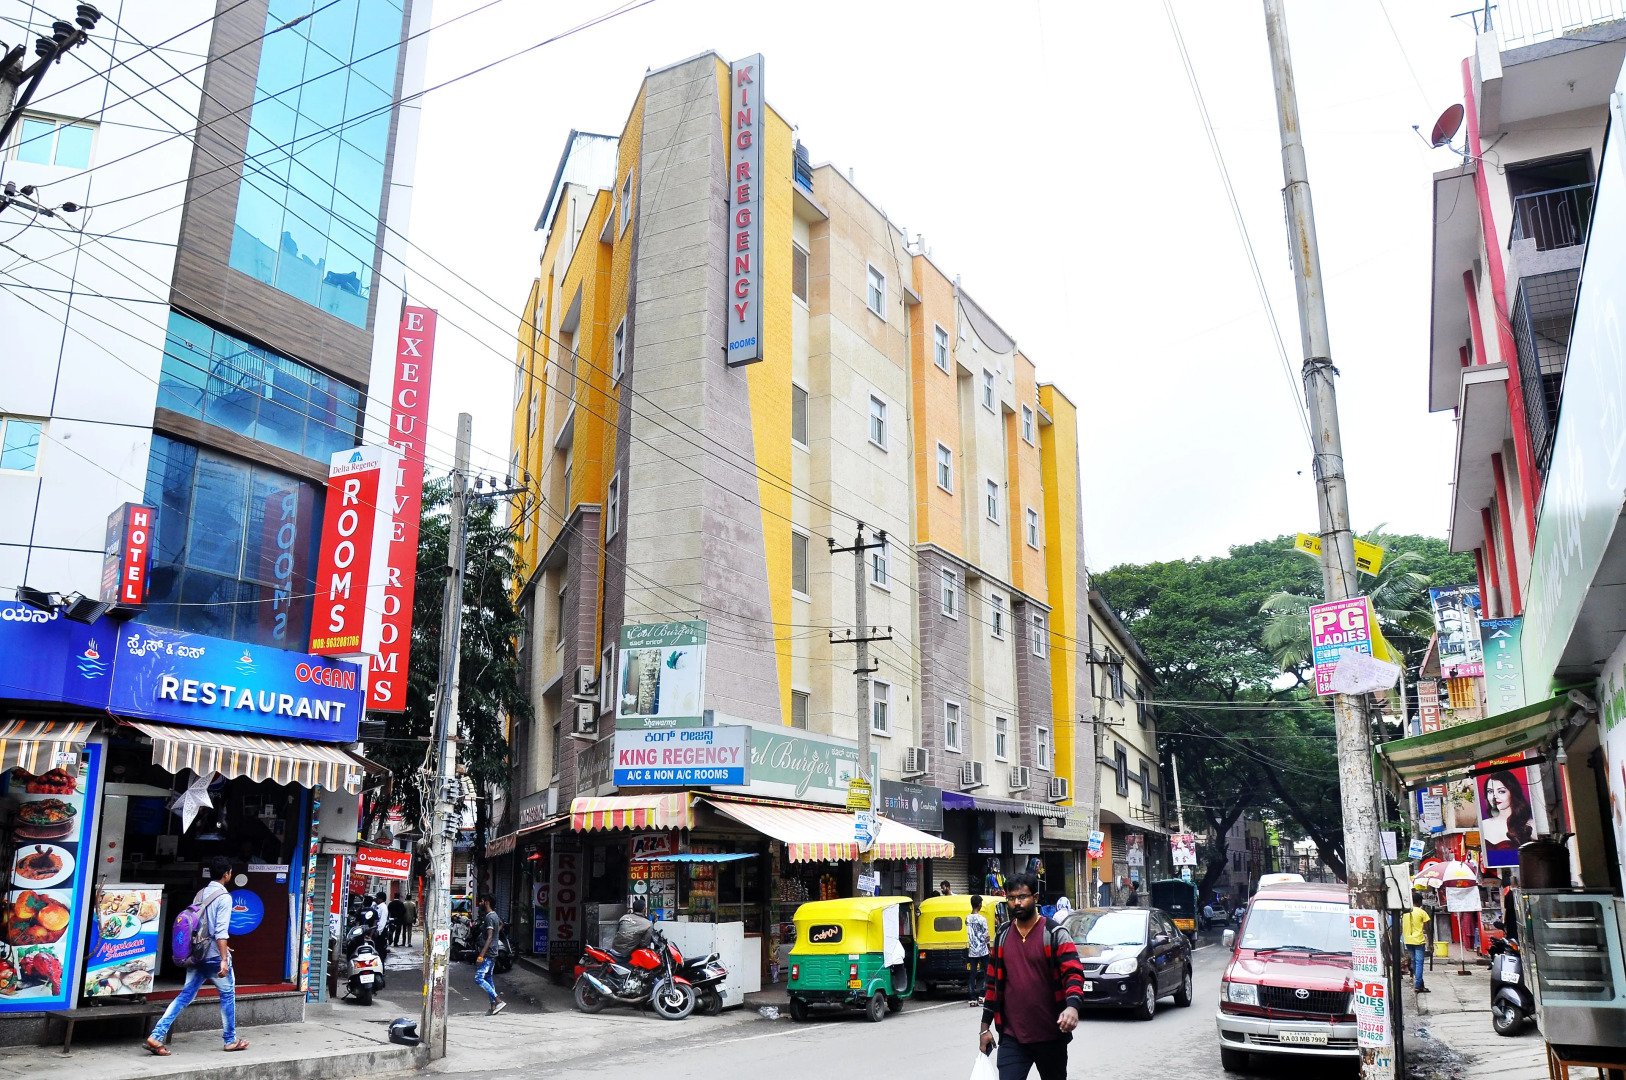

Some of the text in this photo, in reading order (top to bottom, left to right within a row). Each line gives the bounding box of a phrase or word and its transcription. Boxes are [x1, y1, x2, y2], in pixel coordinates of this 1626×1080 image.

[734, 65, 753, 323] KING REGENCY
[729, 337, 756, 351] ROOMS
[333, 460, 379, 474] Delta Regency
[370, 311, 424, 702] EXECUTIVE ROOMS
[126, 512, 148, 599] HOTEL
[328, 478, 361, 634] ROOMS
[654, 623, 695, 646] Burger
[1313, 607, 1366, 637] PG
[165, 643, 174, 655] &
[1315, 628, 1367, 647] LADIES
[294, 662, 356, 690] OCEAN
[1489, 629, 1520, 712] Aishwary
[159, 676, 346, 723] RESTAURANT
[643, 717, 677, 728] Shawarma
[619, 746, 740, 766] KING REGENCY
[771, 738, 831, 798] Burger
[627, 769, 729, 780] A/C & NON A/C ROOMS
[395, 858, 408, 867] 4G
[555, 854, 578, 940] ROOMS
[1354, 980, 1384, 998] PG
